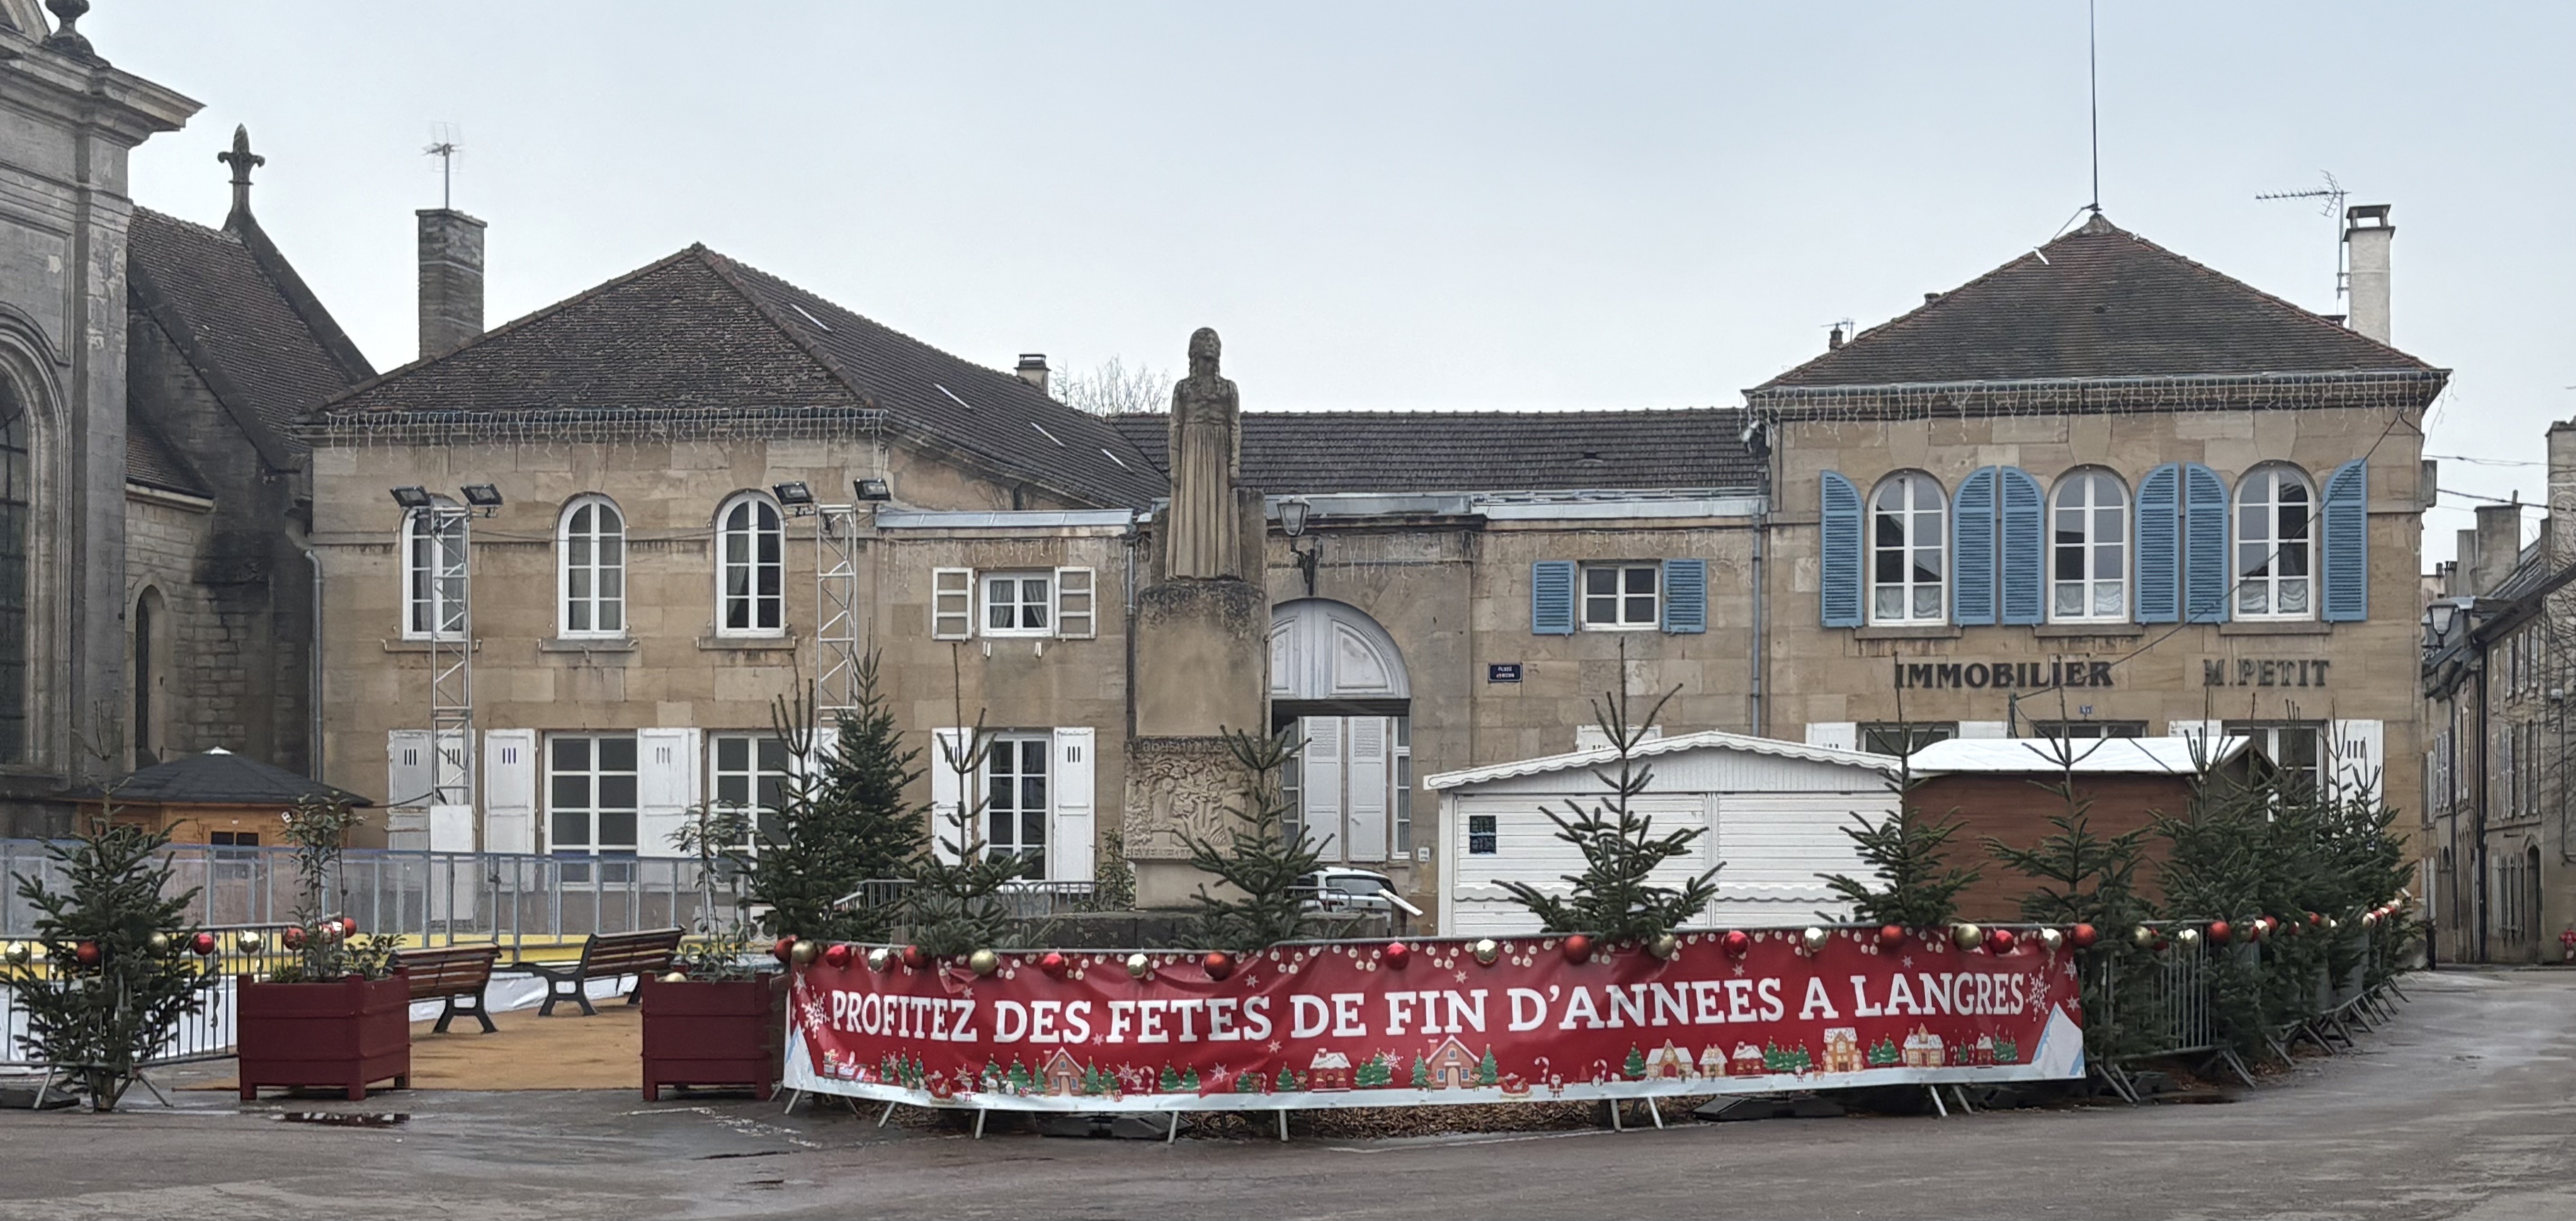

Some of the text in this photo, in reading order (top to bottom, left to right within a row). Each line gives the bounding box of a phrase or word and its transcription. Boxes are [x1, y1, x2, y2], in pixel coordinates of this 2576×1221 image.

[1895, 662, 2114, 689] IMMOBILIER
[832, 973, 2024, 1044] PROFITEZ DES FETES DE FIN D'ANNEES A LANGRES
